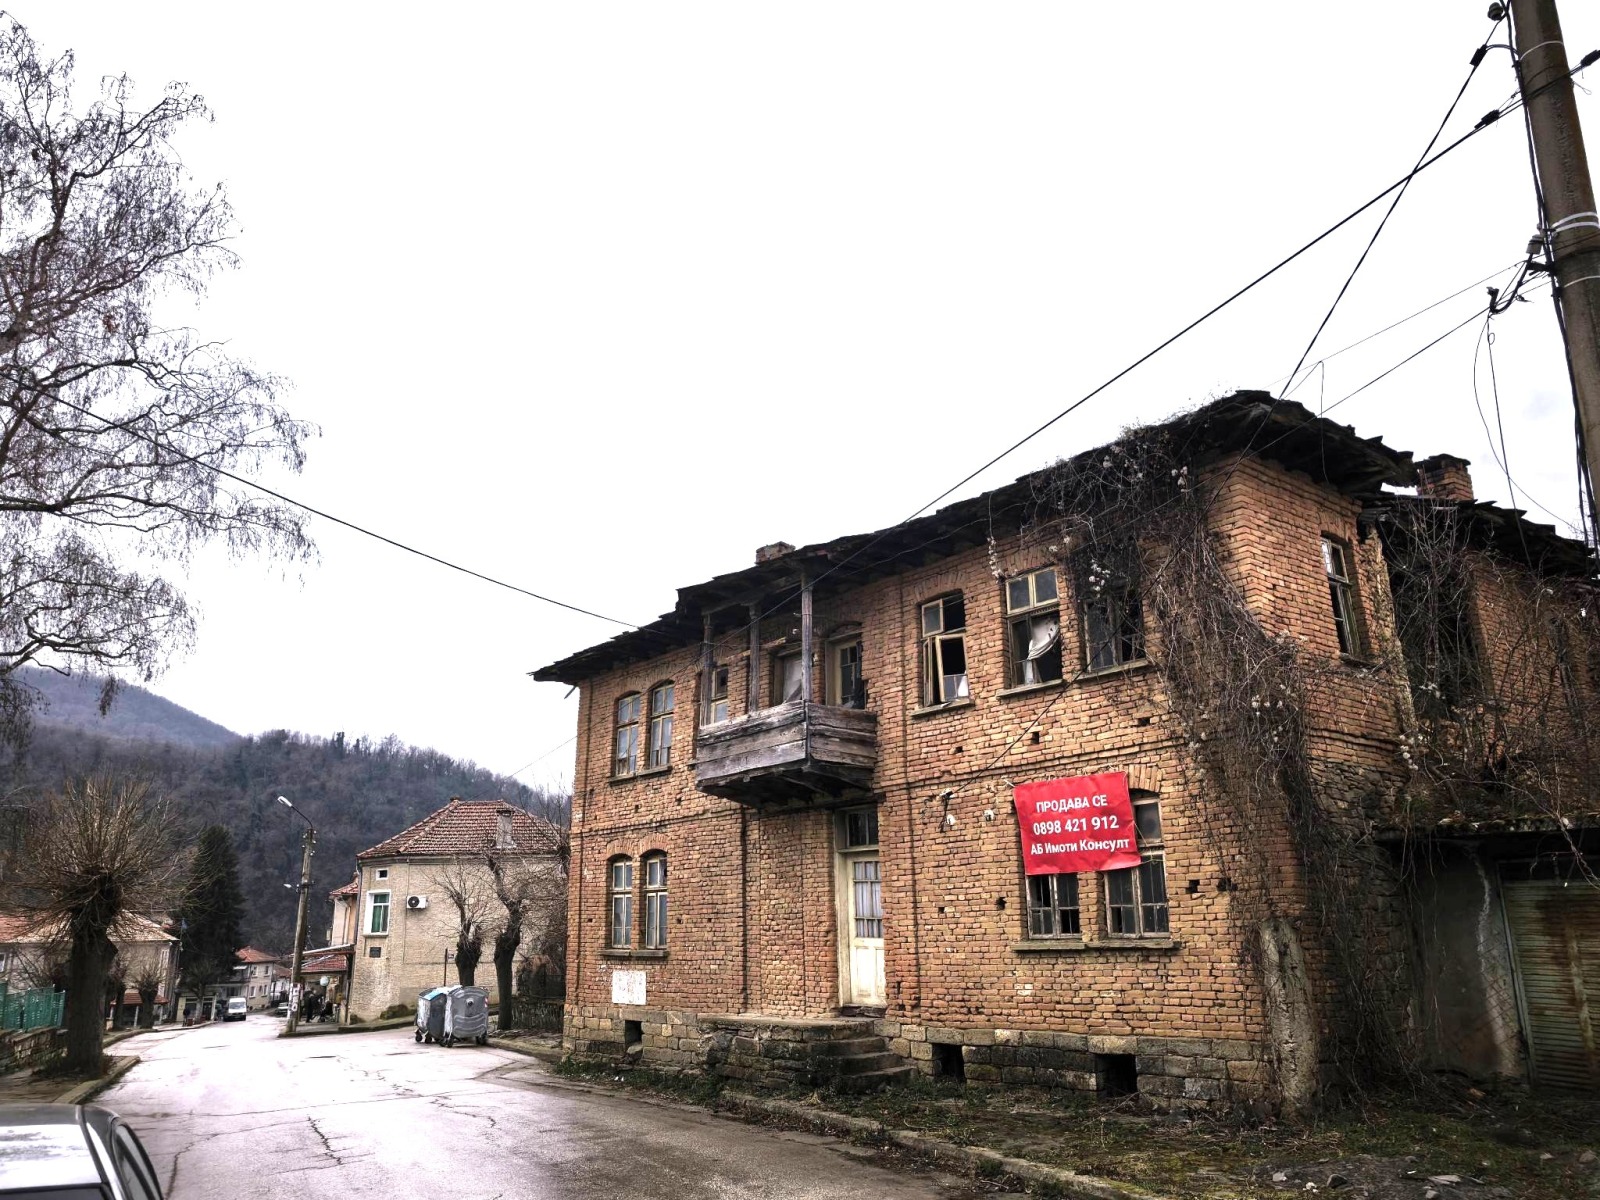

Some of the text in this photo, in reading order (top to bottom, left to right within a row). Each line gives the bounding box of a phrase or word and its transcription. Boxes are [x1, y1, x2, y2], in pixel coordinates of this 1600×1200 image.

[1036, 795, 1107, 813] ПРОДАВА СЕ
[1033, 815, 1119, 835] 0898 421 912
[1031, 839, 1129, 855] АБ Имоти Консулт
